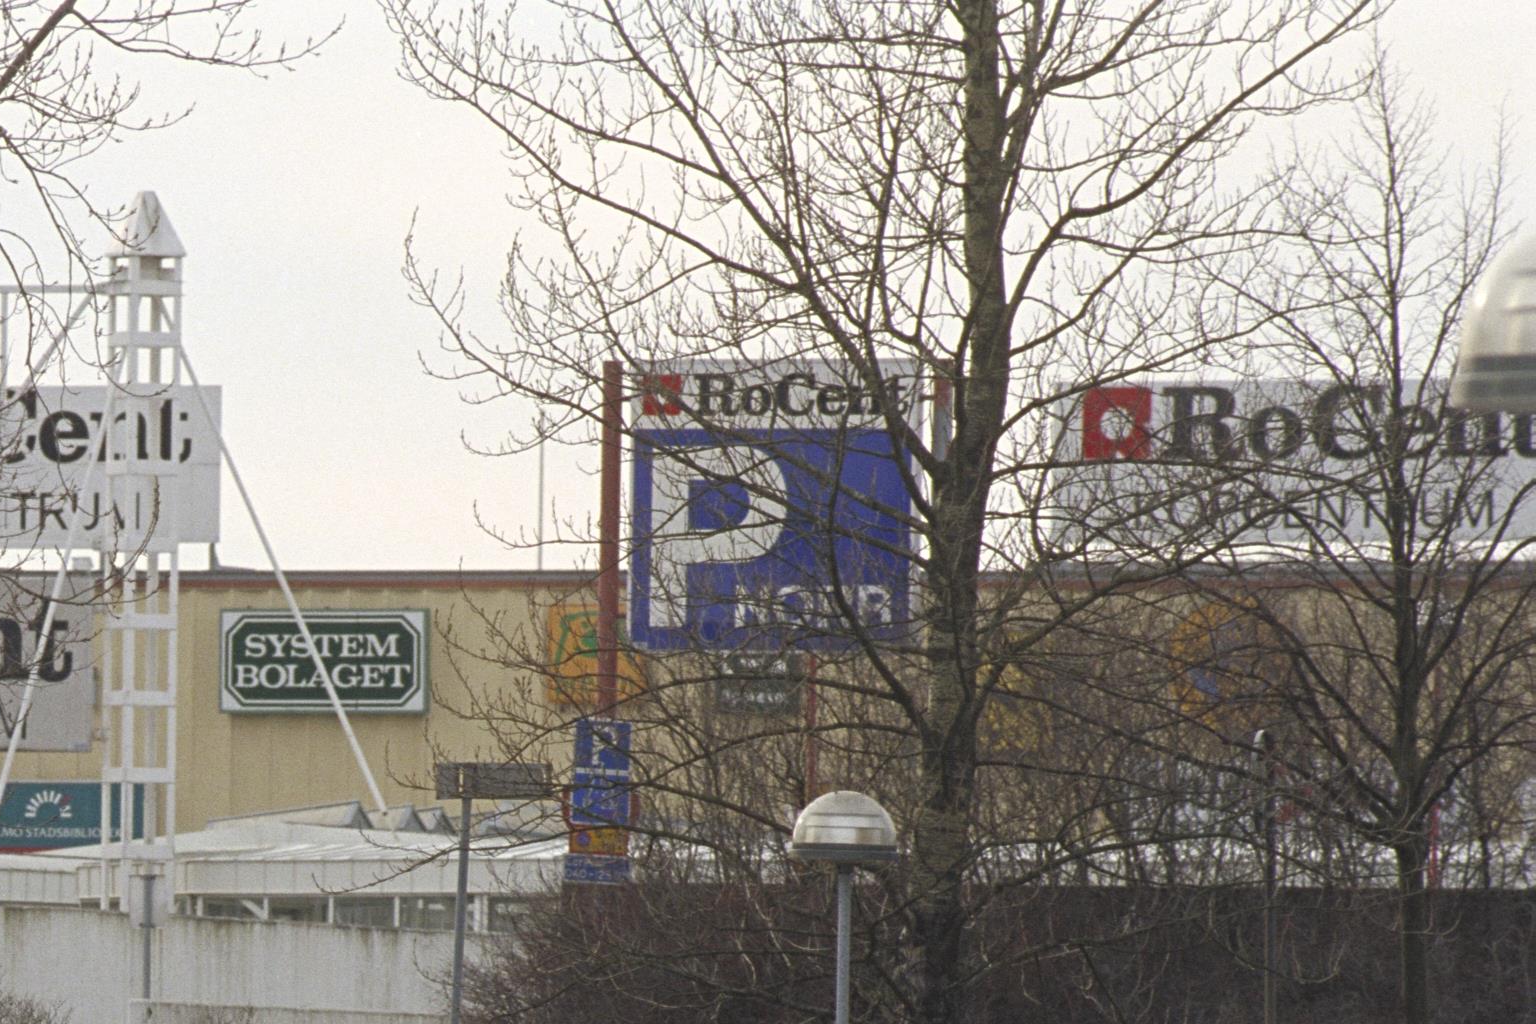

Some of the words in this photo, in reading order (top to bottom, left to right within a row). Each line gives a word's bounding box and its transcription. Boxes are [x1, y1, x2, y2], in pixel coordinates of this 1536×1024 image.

[650, 445, 788, 628] P
[244, 633, 401, 658] SYSTEM
[234, 663, 411, 689] BOLAGET
